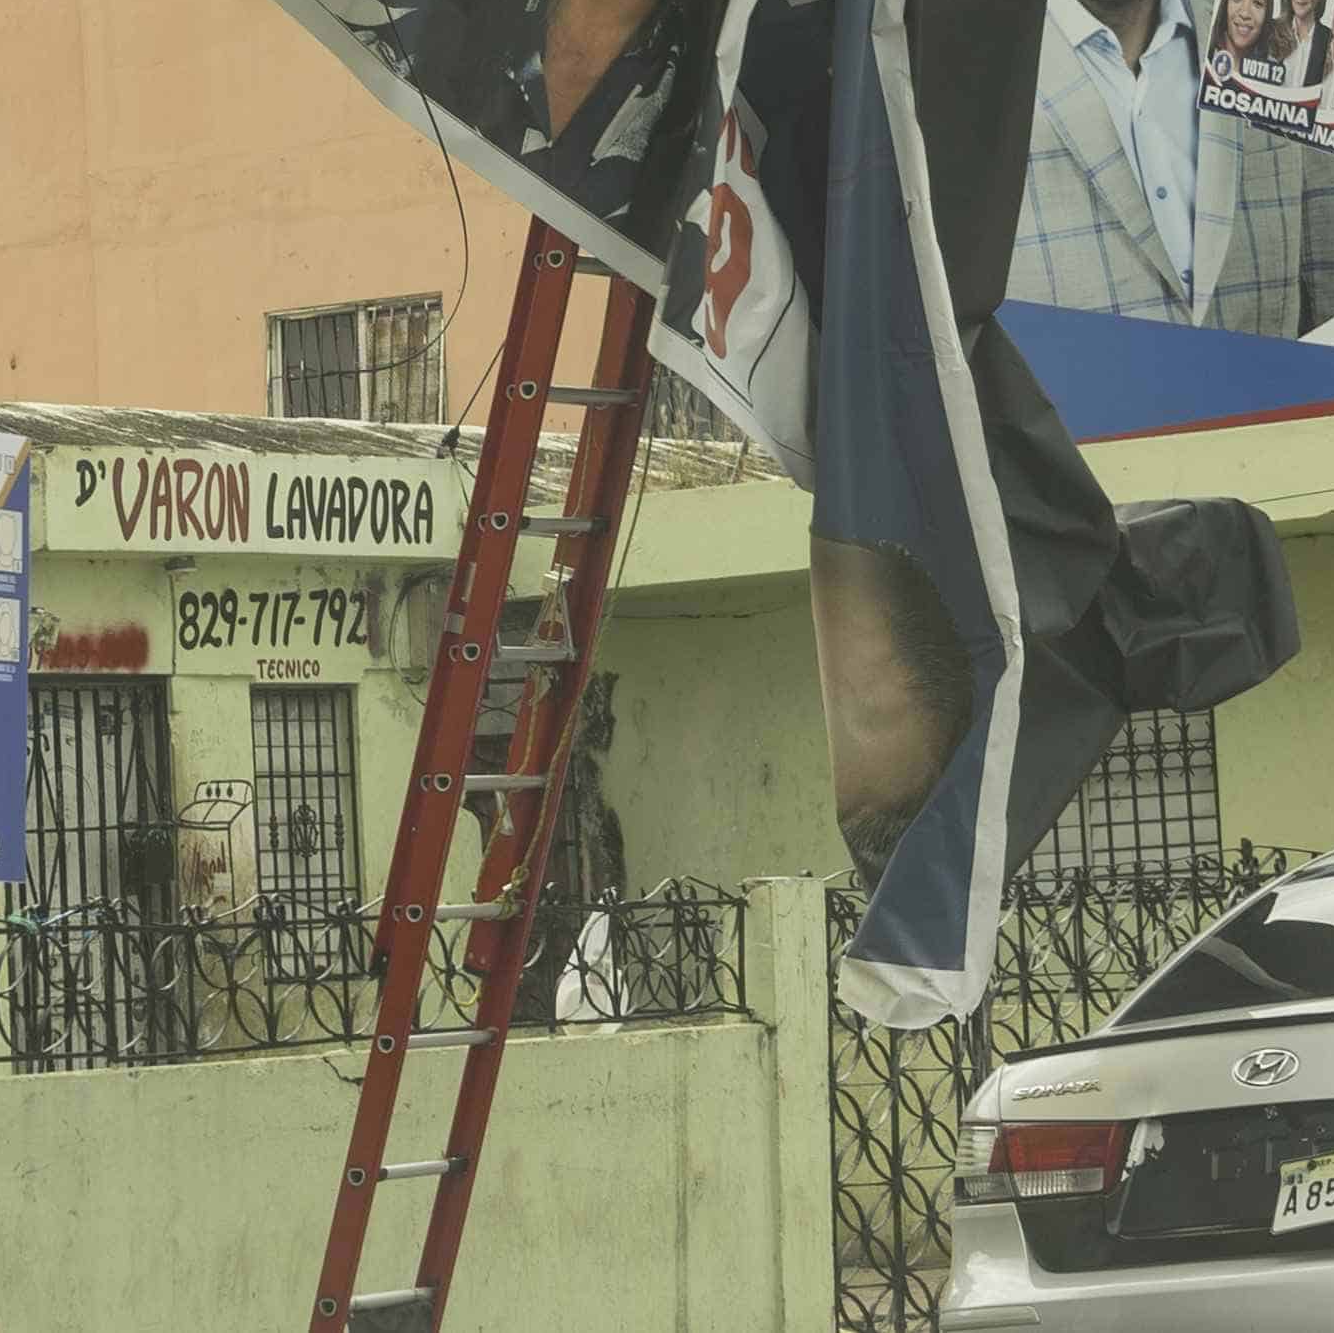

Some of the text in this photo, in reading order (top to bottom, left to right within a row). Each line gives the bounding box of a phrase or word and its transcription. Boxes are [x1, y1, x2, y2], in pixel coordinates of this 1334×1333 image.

[1243, 58, 1285, 82] VOTA 12
[1203, 86, 1308, 127] ROSANNA
[266, 472, 433, 545] LAVADORA
[257, 659, 321, 680] TECNICO
[1012, 1079, 1101, 1101] SONATA
